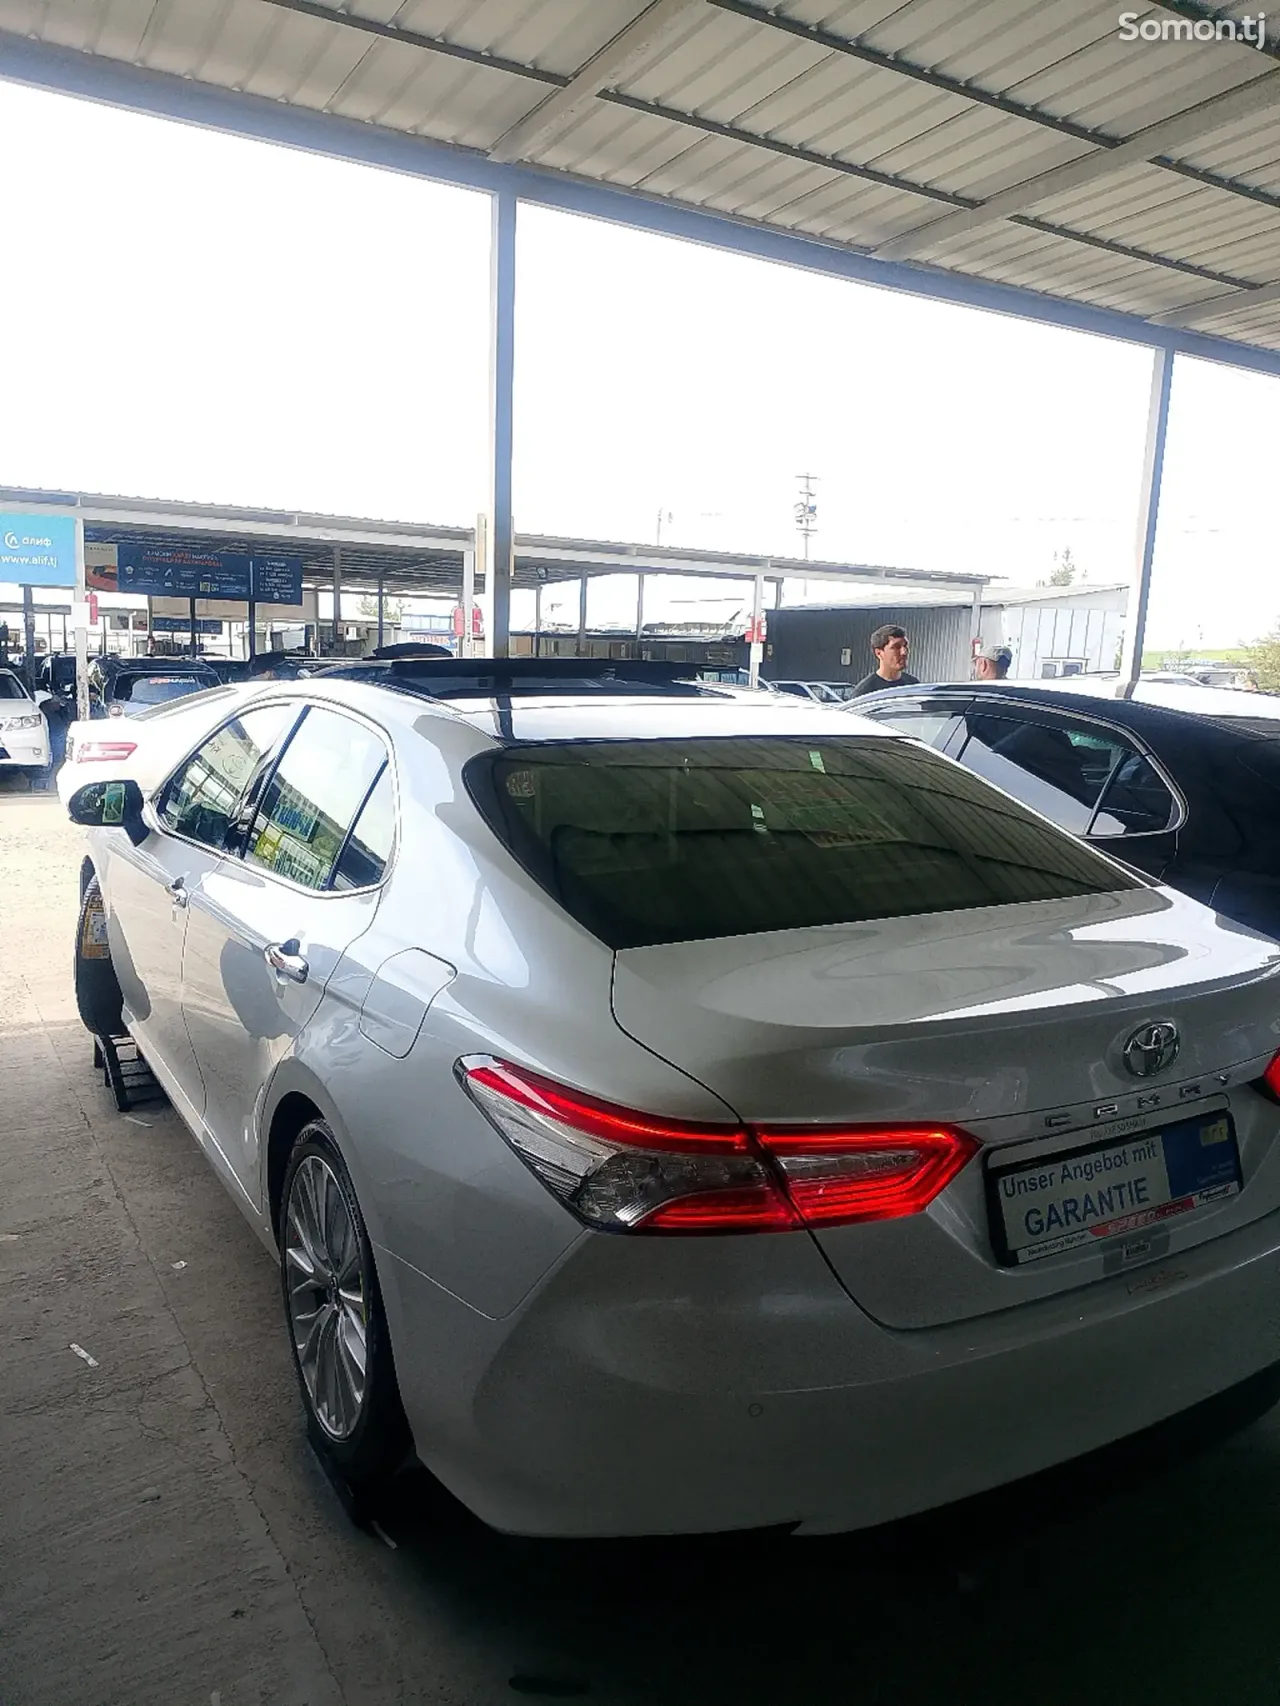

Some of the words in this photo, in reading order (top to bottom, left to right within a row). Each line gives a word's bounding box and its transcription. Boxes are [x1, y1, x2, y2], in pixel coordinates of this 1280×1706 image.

[1, 555, 58, 569] www.alif.tj
[1044, 1073, 1230, 1128] CAMRY
[1002, 1175, 1055, 1198] Unser
[1060, 1149, 1129, 1184] Angebot
[1131, 1140, 1158, 1163] mit
[1024, 1176, 1150, 1236] GARANTIE
